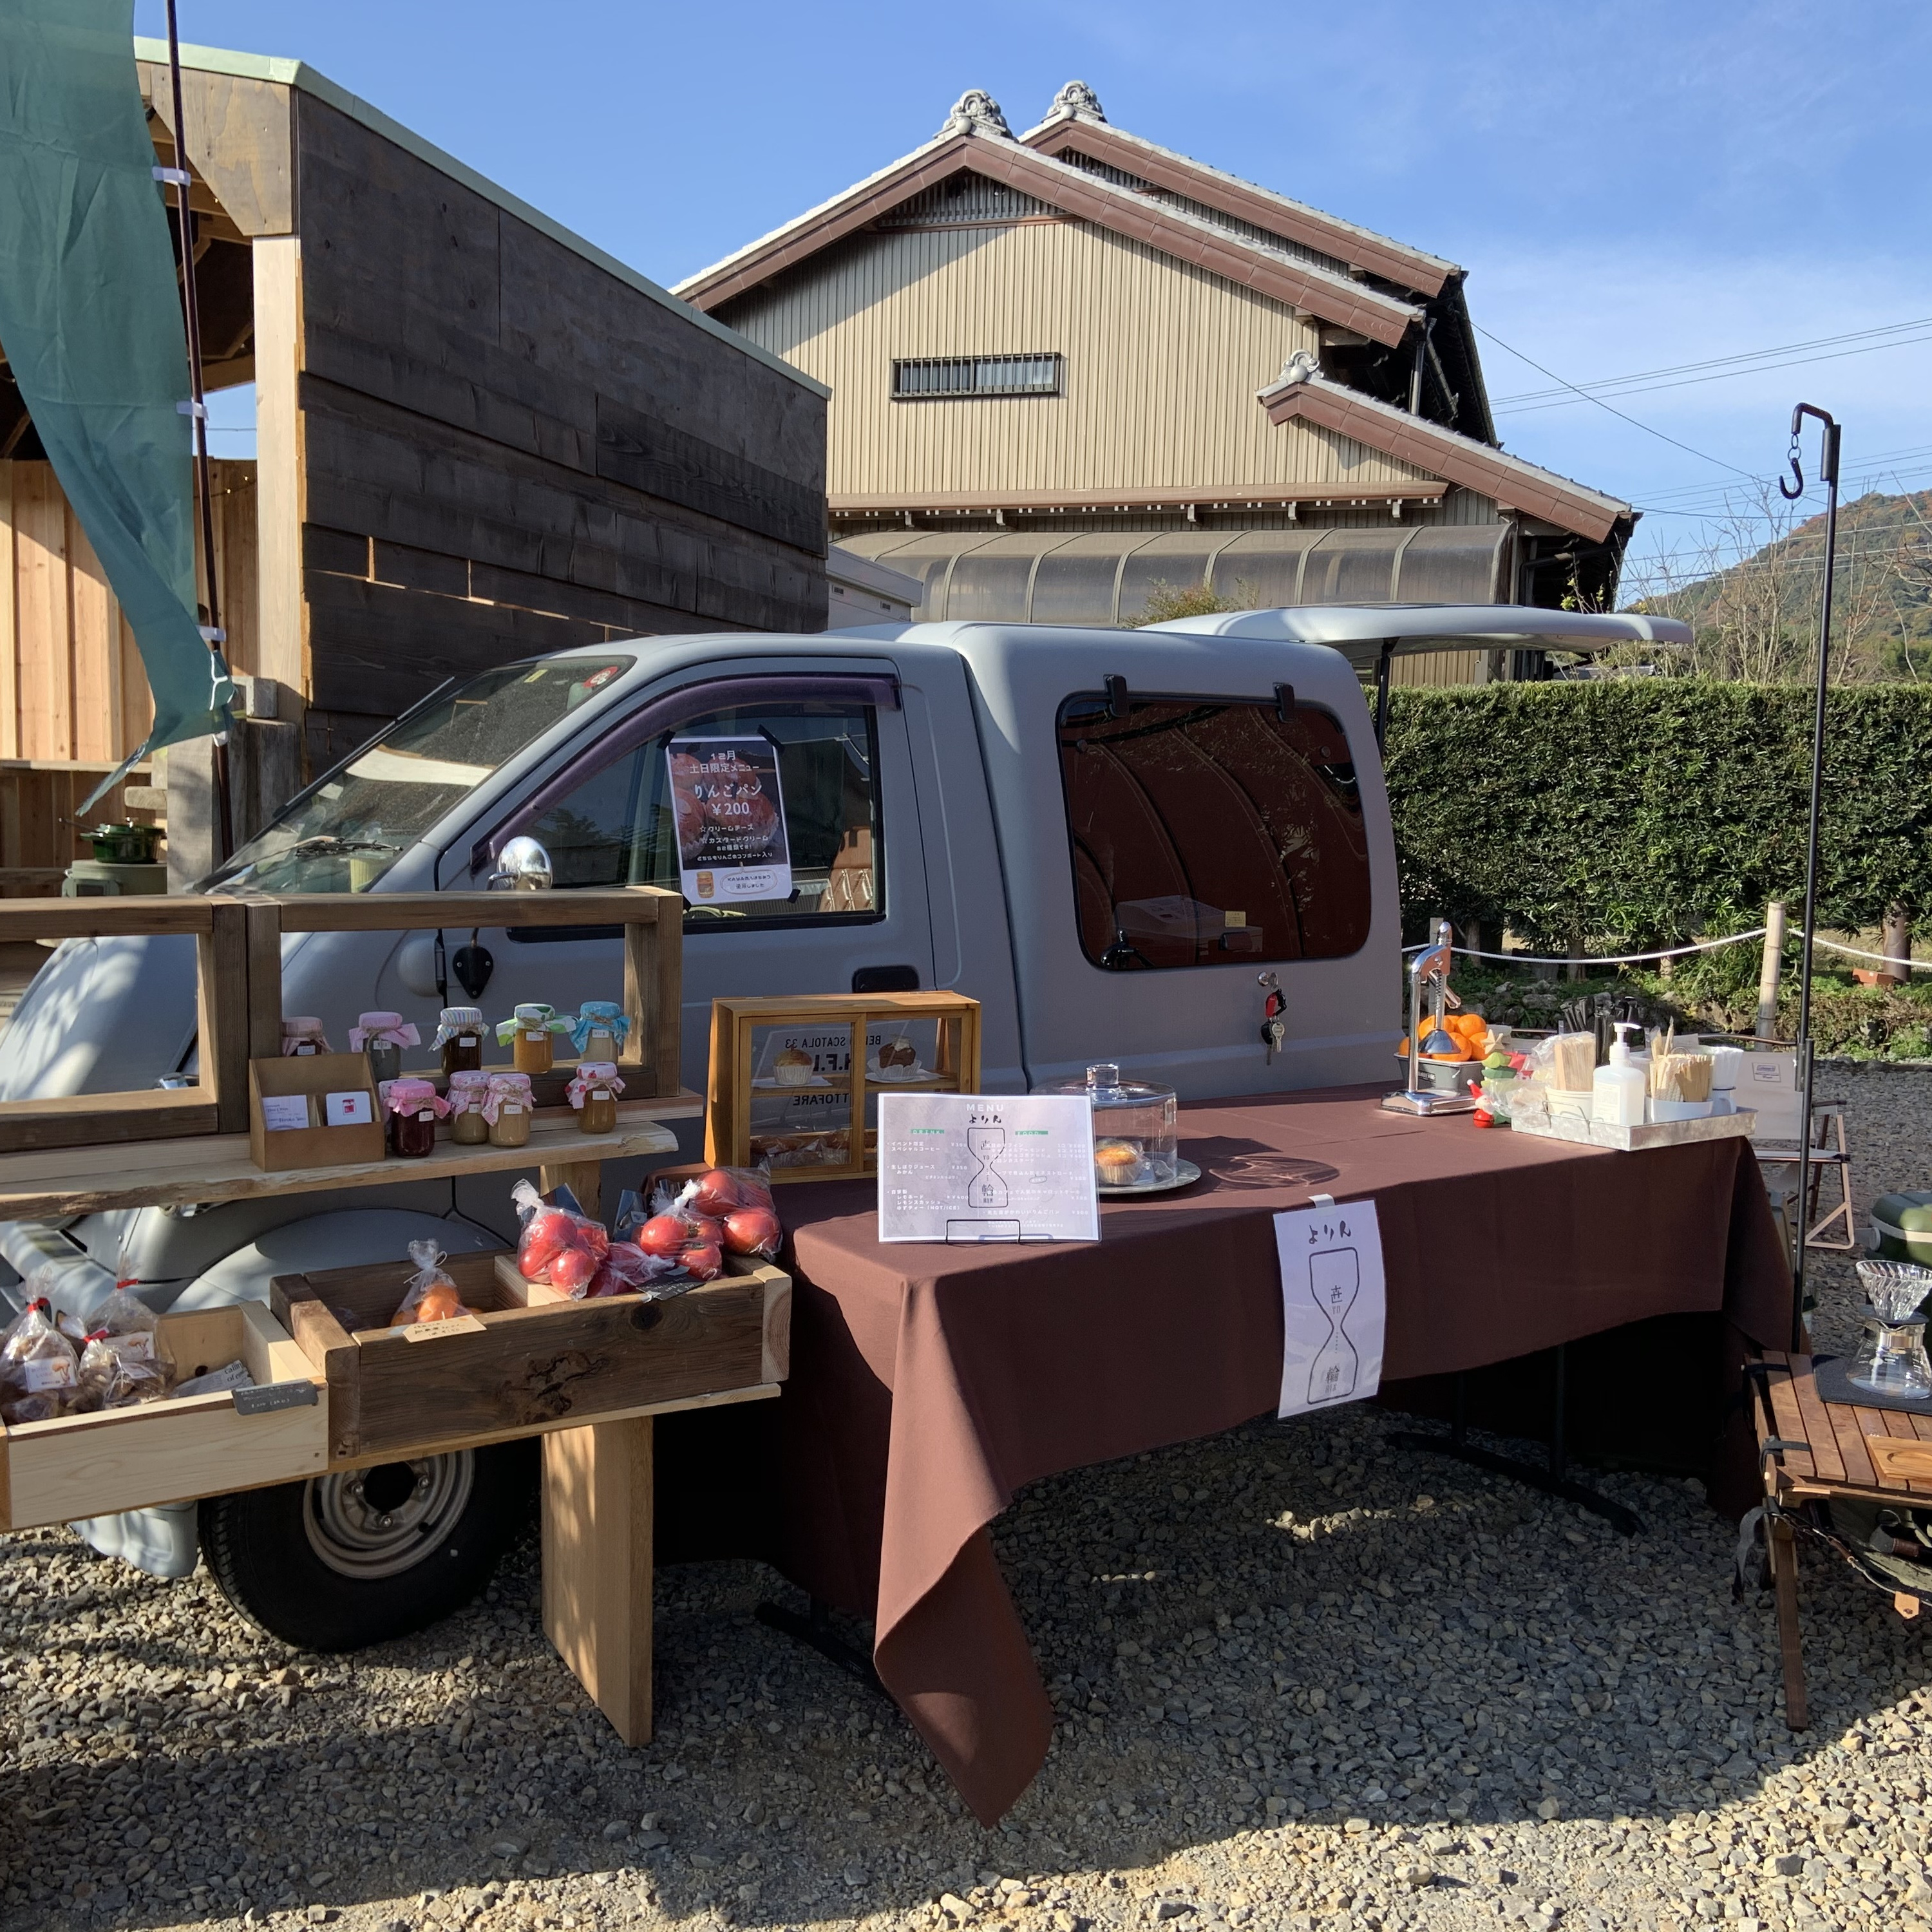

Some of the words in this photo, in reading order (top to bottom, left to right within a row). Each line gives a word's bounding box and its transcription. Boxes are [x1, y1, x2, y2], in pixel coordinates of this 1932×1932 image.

[710, 750, 736, 761] 12月
[690, 762, 759, 775] 土日限定メニュー
[694, 783, 762, 799] りんごパン
[712, 802, 750, 815] ¥200
[966, 1103, 1005, 1112] MENU
